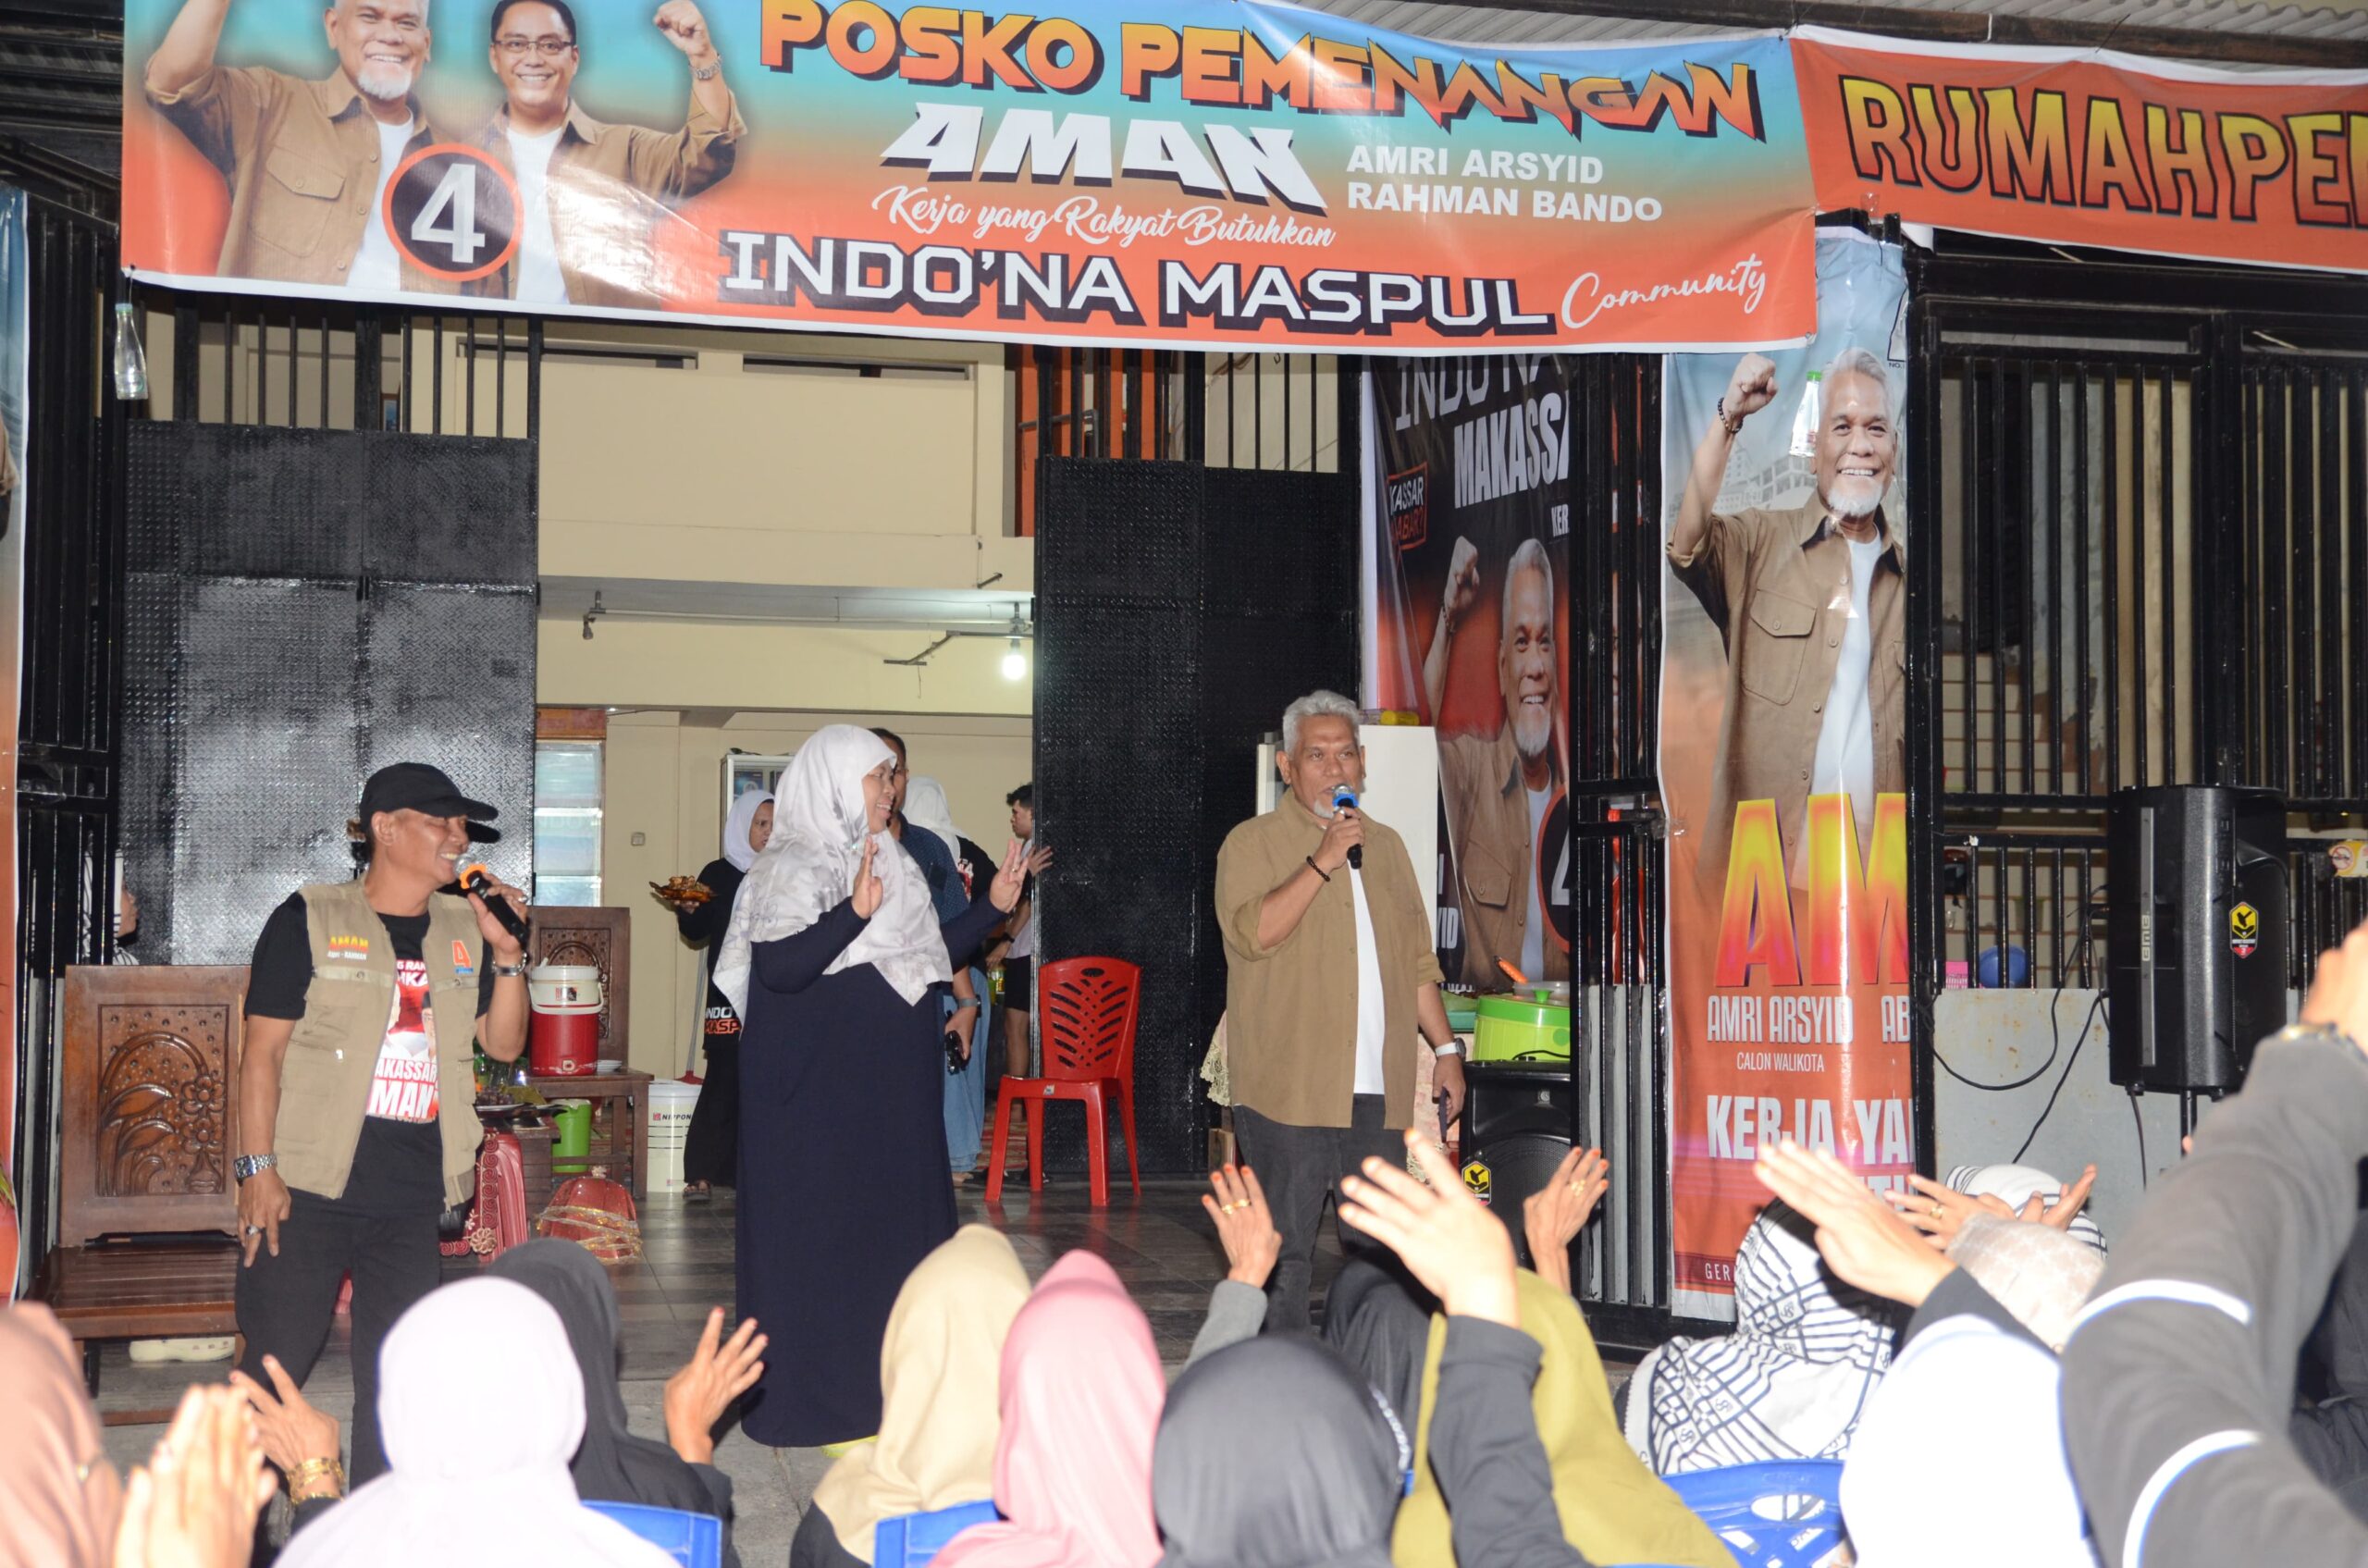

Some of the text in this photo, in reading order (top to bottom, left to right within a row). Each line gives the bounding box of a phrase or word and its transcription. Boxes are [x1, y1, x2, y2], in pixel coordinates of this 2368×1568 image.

[760, 0, 1765, 142] POSKO PEMENANGAN
[881, 103, 1326, 216] AMAN
[1347, 145, 1603, 185] AMRI ARSYID
[412, 163, 486, 264] 4
[871, 186, 1336, 248] Kerja yang Rakyat Butuhkan
[1348, 182, 1663, 223] RAHMAN BANDO
[722, 230, 1765, 335] INDO'NA MASPUL Community
[1707, 994, 1763, 1043] AMRI
[1769, 995, 1854, 1044] ARSYID
[1736, 1052, 1825, 1072] CALON WALIKOTA
[1705, 1262, 1737, 1282] GER
